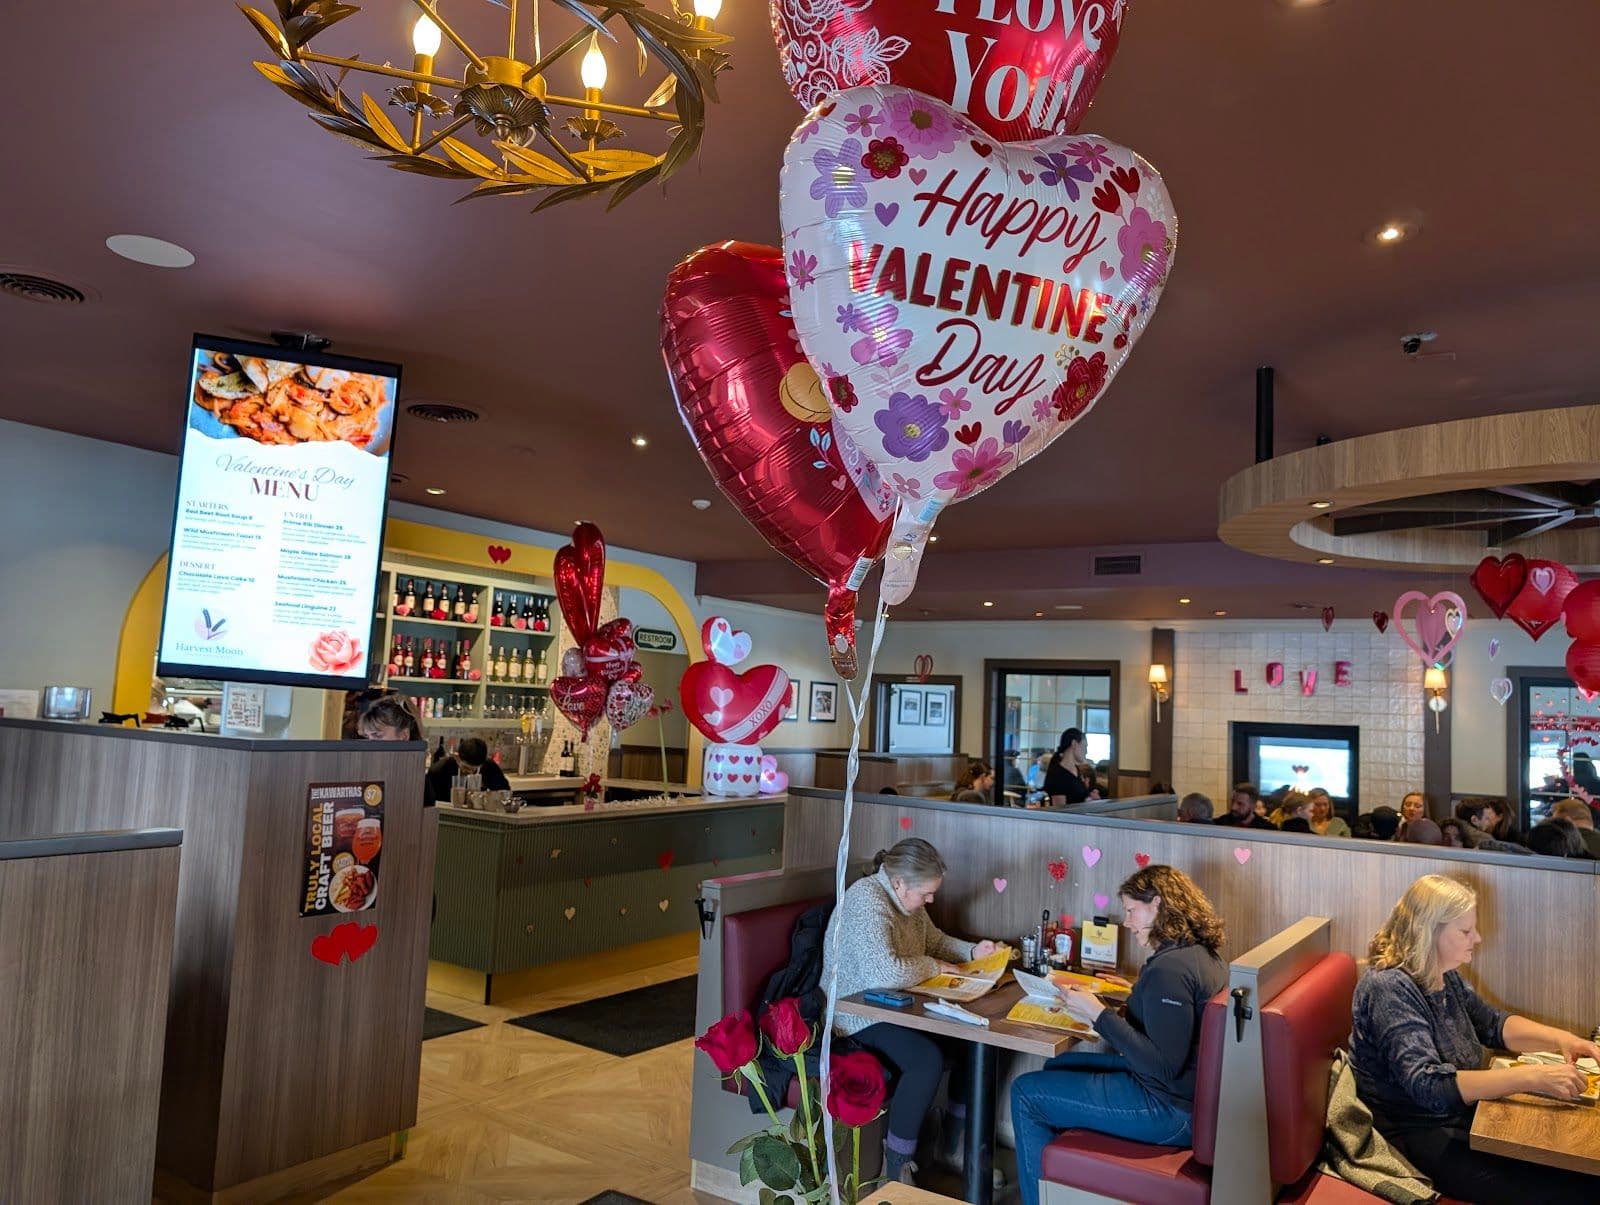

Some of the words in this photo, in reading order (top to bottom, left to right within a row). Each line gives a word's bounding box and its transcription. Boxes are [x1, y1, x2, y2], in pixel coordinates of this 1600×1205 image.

[944, 30, 1085, 136] You!
[913, 167, 1107, 274] Happy
[915, 318, 1047, 416] Day
[216, 454, 308, 480] Valentine's
[312, 467, 355, 490] Day
[250, 477, 319, 501] MENU
[186, 500, 229, 511] STARTERS
[178, 570, 213, 579] Chocolate
[179, 560, 216, 570] DESSERT
[275, 600, 301, 608] Seafood
[301, 602, 328, 611] Linguine
[176, 642, 212, 653] Harvest
[215, 645, 244, 656] Moon
[639, 633, 672, 644] RESTROOM
[1234, 661, 1352, 697] LOVE
[749, 700, 773, 728] XOXO
[320, 786, 363, 800] KAWARTHAS
[311, 802, 324, 856] LOCAL
[321, 801, 335, 848] BEER
[304, 857, 320, 913] TRULY
[315, 852, 332, 911] CRAFT
